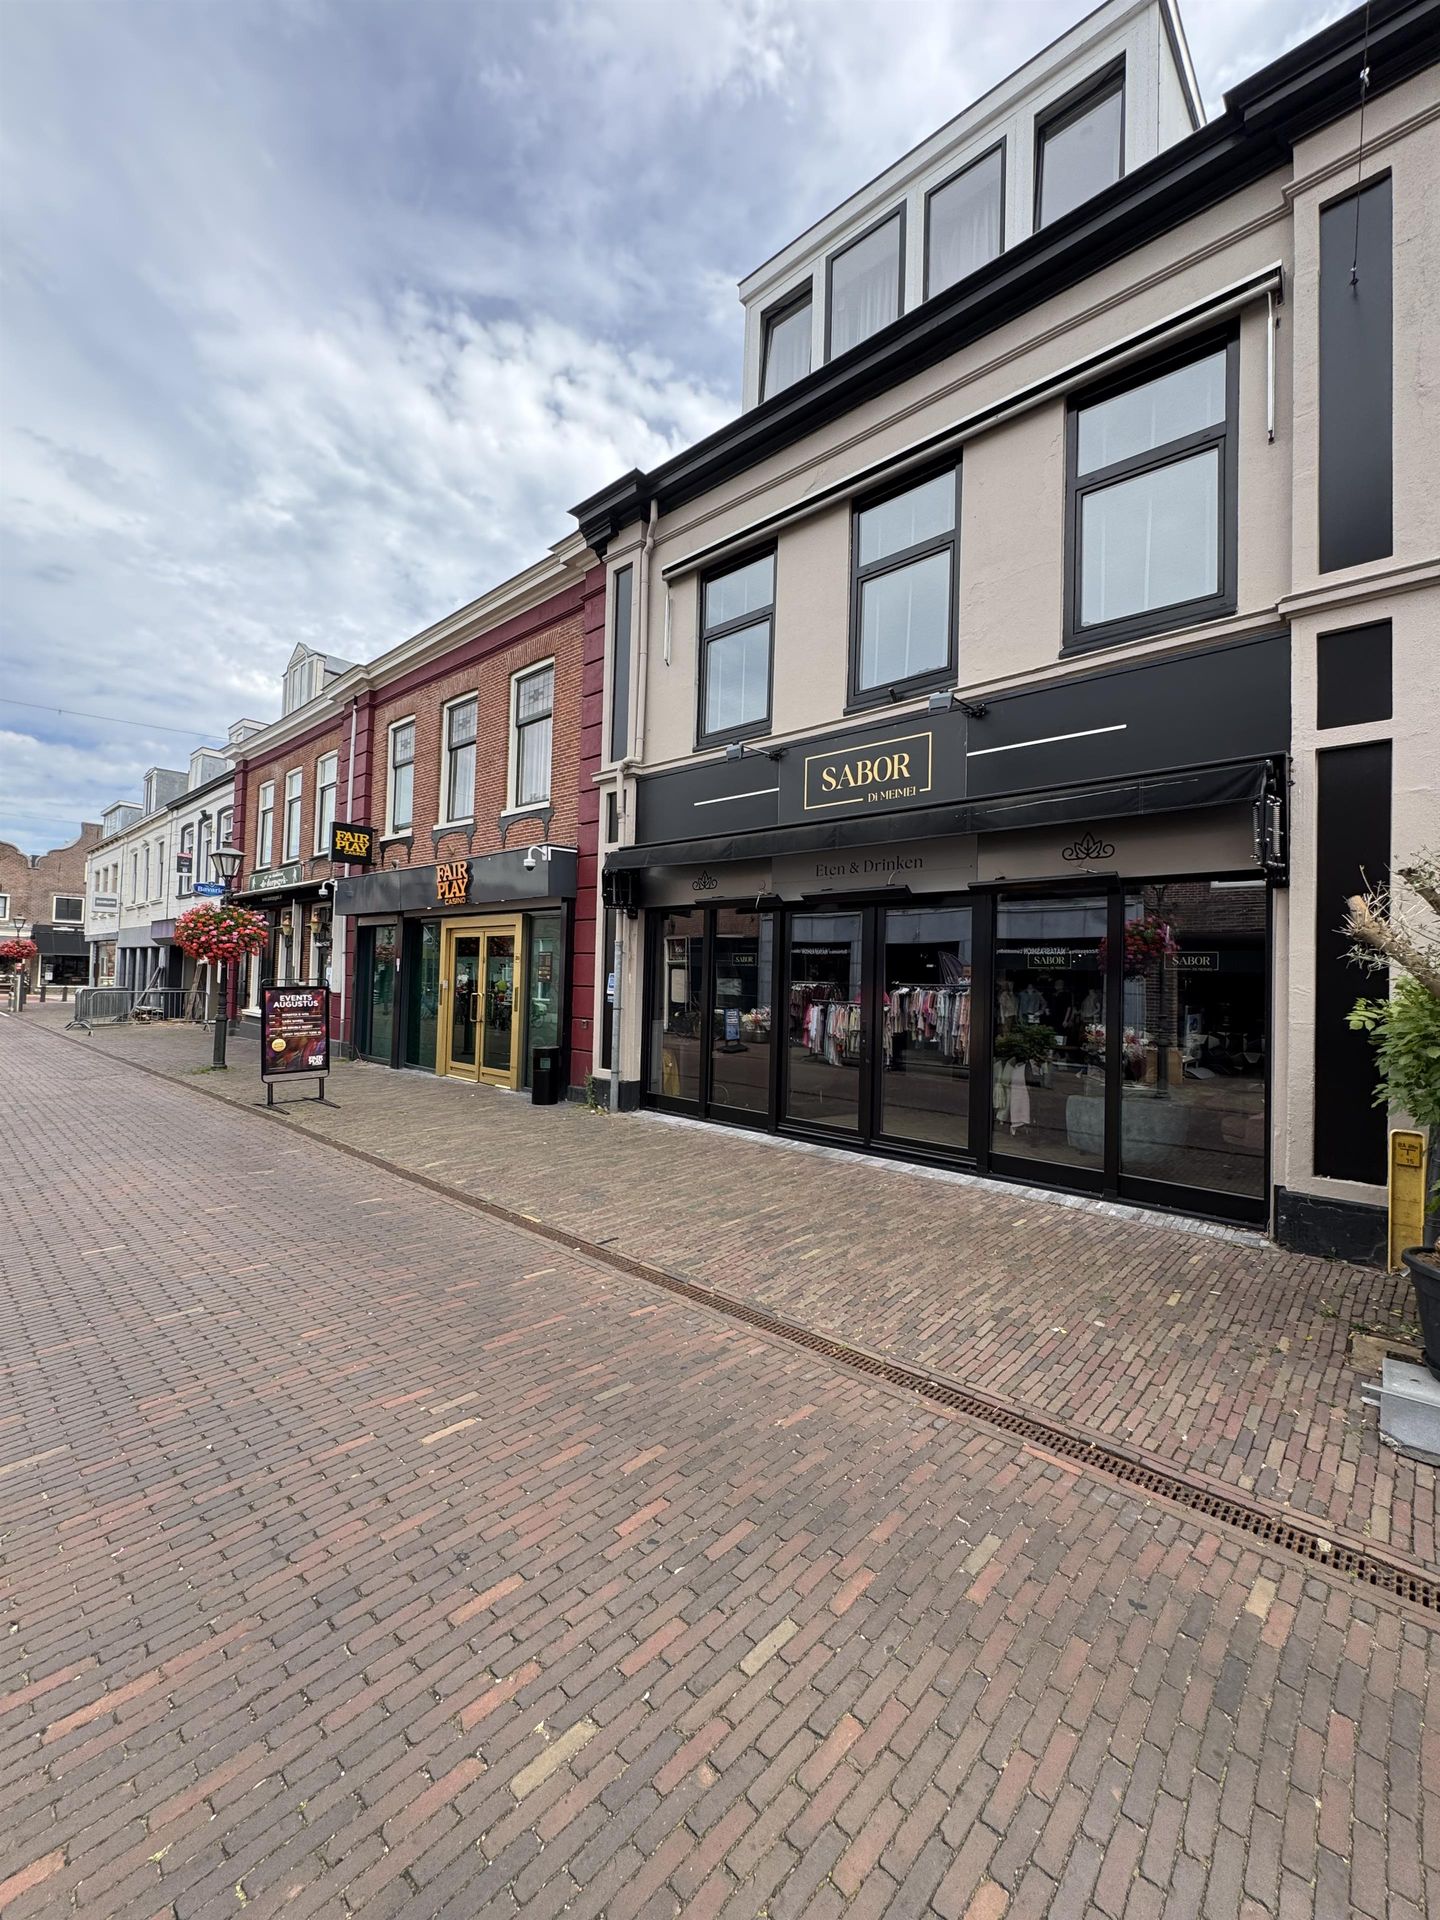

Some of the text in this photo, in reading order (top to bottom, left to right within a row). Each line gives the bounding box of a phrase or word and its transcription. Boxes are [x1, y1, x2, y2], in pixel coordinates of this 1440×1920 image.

[822, 753, 911, 792] SABOR
[880, 786, 916, 800] MEIMEI
[336, 830, 369, 844] FAIR
[336, 840, 369, 852] PLAY
[436, 861, 468, 881] FAIR
[816, 856, 923, 877] Eten & Drinken
[437, 879, 468, 899] PLAY
[444, 896, 466, 906] CASINO
[1033, 956, 1065, 965] SABOR
[1171, 956, 1210, 966] SABOR
